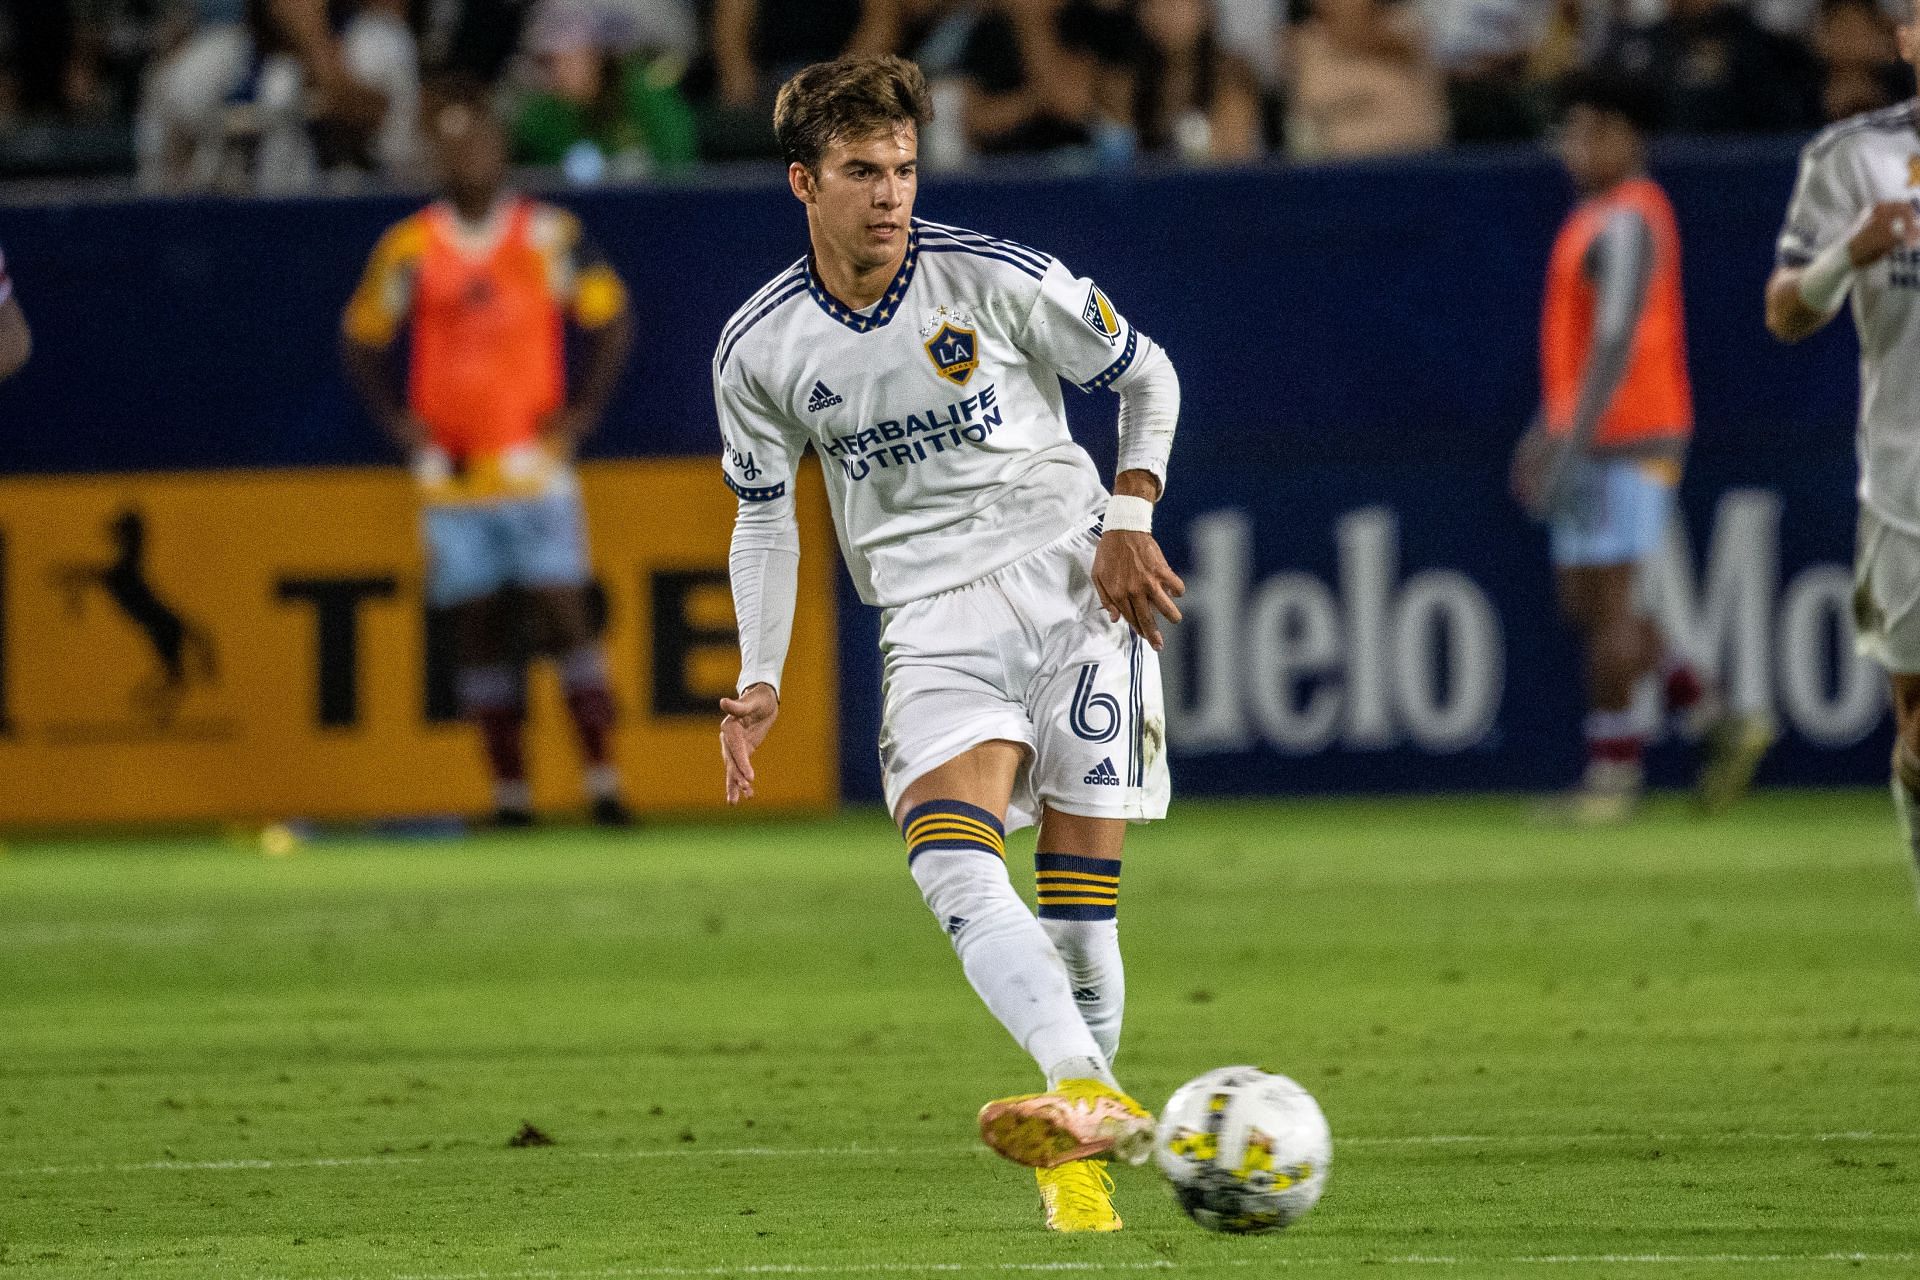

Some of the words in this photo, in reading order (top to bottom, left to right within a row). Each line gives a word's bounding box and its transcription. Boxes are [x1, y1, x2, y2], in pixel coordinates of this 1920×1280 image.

[1086, 300, 1098, 324] MLS
[939, 344, 970, 364] LA
[942, 361, 975, 375] GALAXY
[808, 394, 844, 413] adidas
[822, 383, 998, 457] HERBALIFE
[839, 405, 1004, 481] NUTRITION
[1069, 663, 1121, 744] 6
[1083, 773, 1120, 786] adidas
